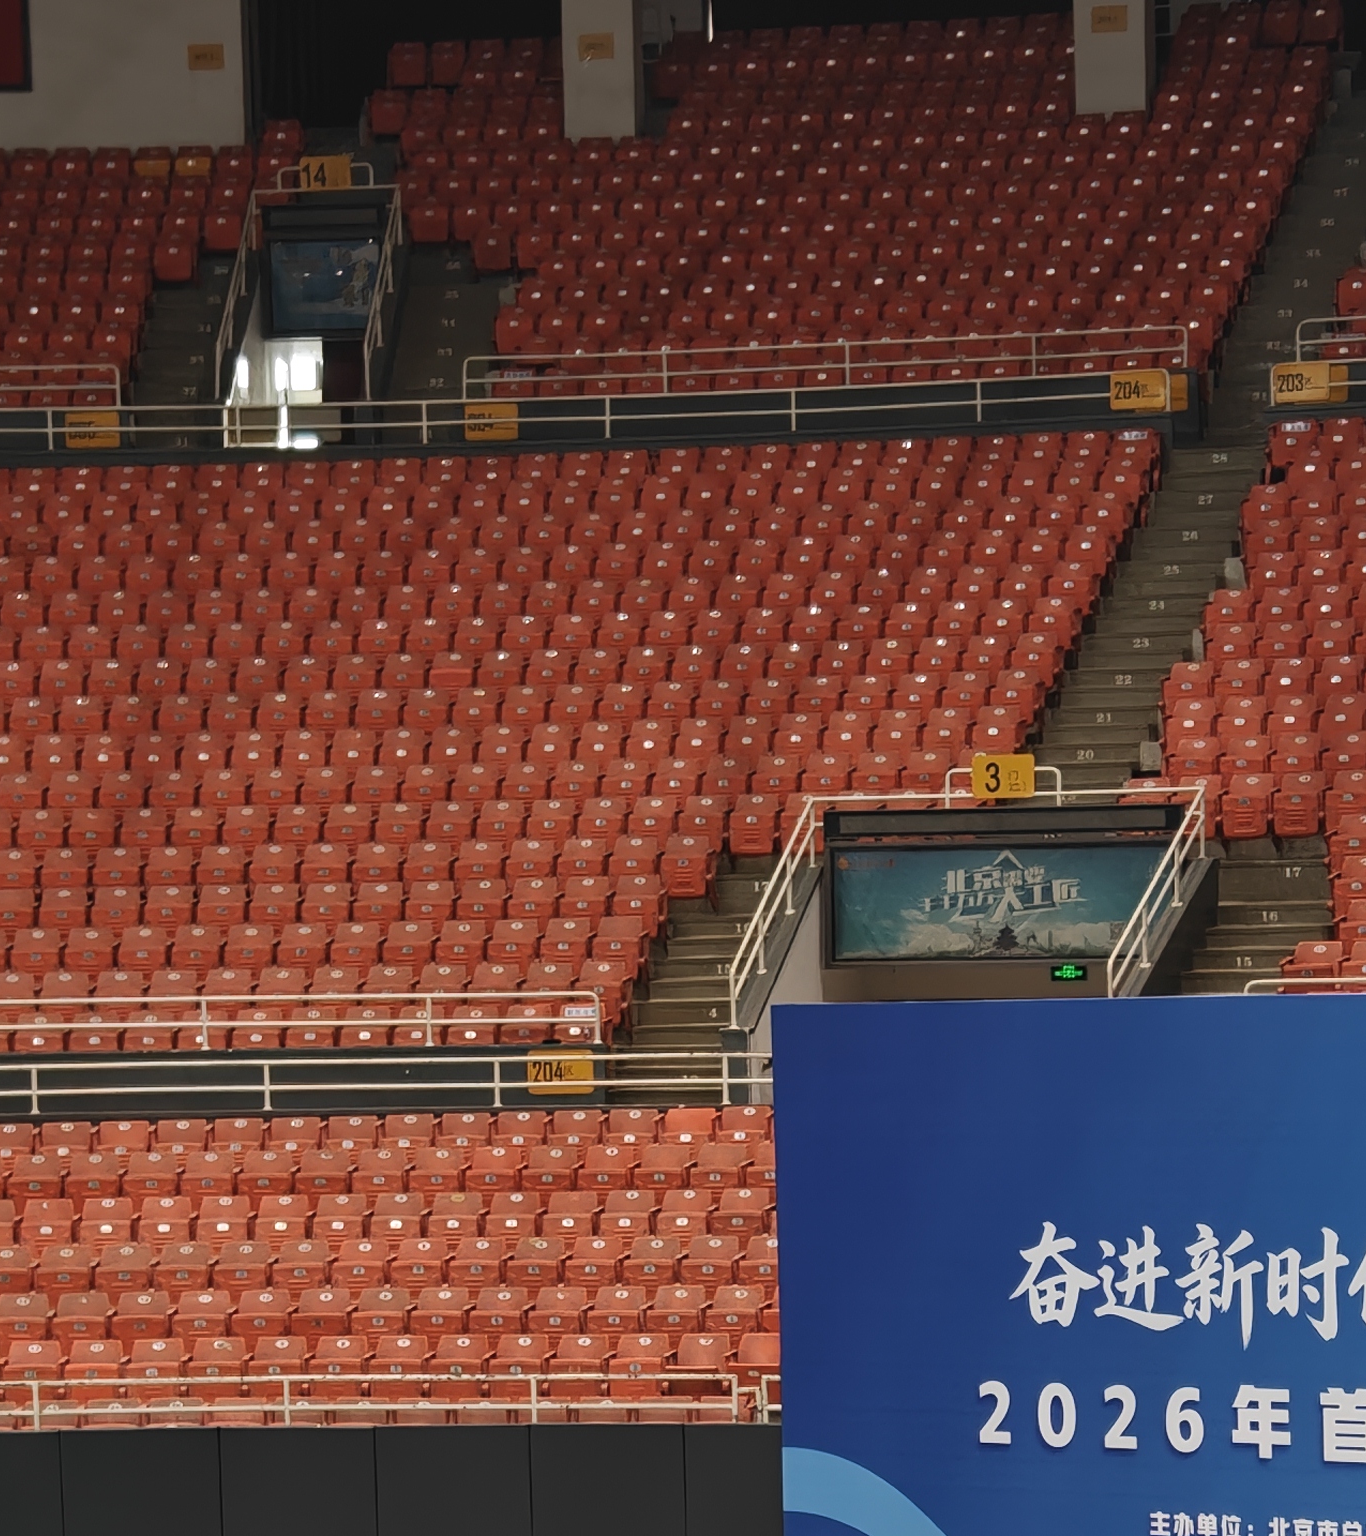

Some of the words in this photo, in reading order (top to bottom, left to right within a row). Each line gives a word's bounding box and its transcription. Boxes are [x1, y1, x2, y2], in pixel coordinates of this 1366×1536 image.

[301, 162, 327, 188] 14
[1277, 373, 1304, 393] 203
[1114, 381, 1140, 400] 204
[1212, 453, 1228, 464] 28
[1198, 494, 1214, 505] 27
[1182, 530, 1198, 541] 26
[1163, 564, 1180, 576] 25
[1148, 600, 1165, 611] 24
[1133, 637, 1150, 648] 23
[1114, 674, 1133, 685] 22
[1096, 712, 1112, 723] 21
[1076, 749, 1094, 760] 20
[985, 761, 1001, 793] 3
[1285, 867, 1302, 878] 17
[1262, 910, 1279, 922] 16
[1236, 956, 1252, 967] 15
[532, 1061, 564, 1082] 204
